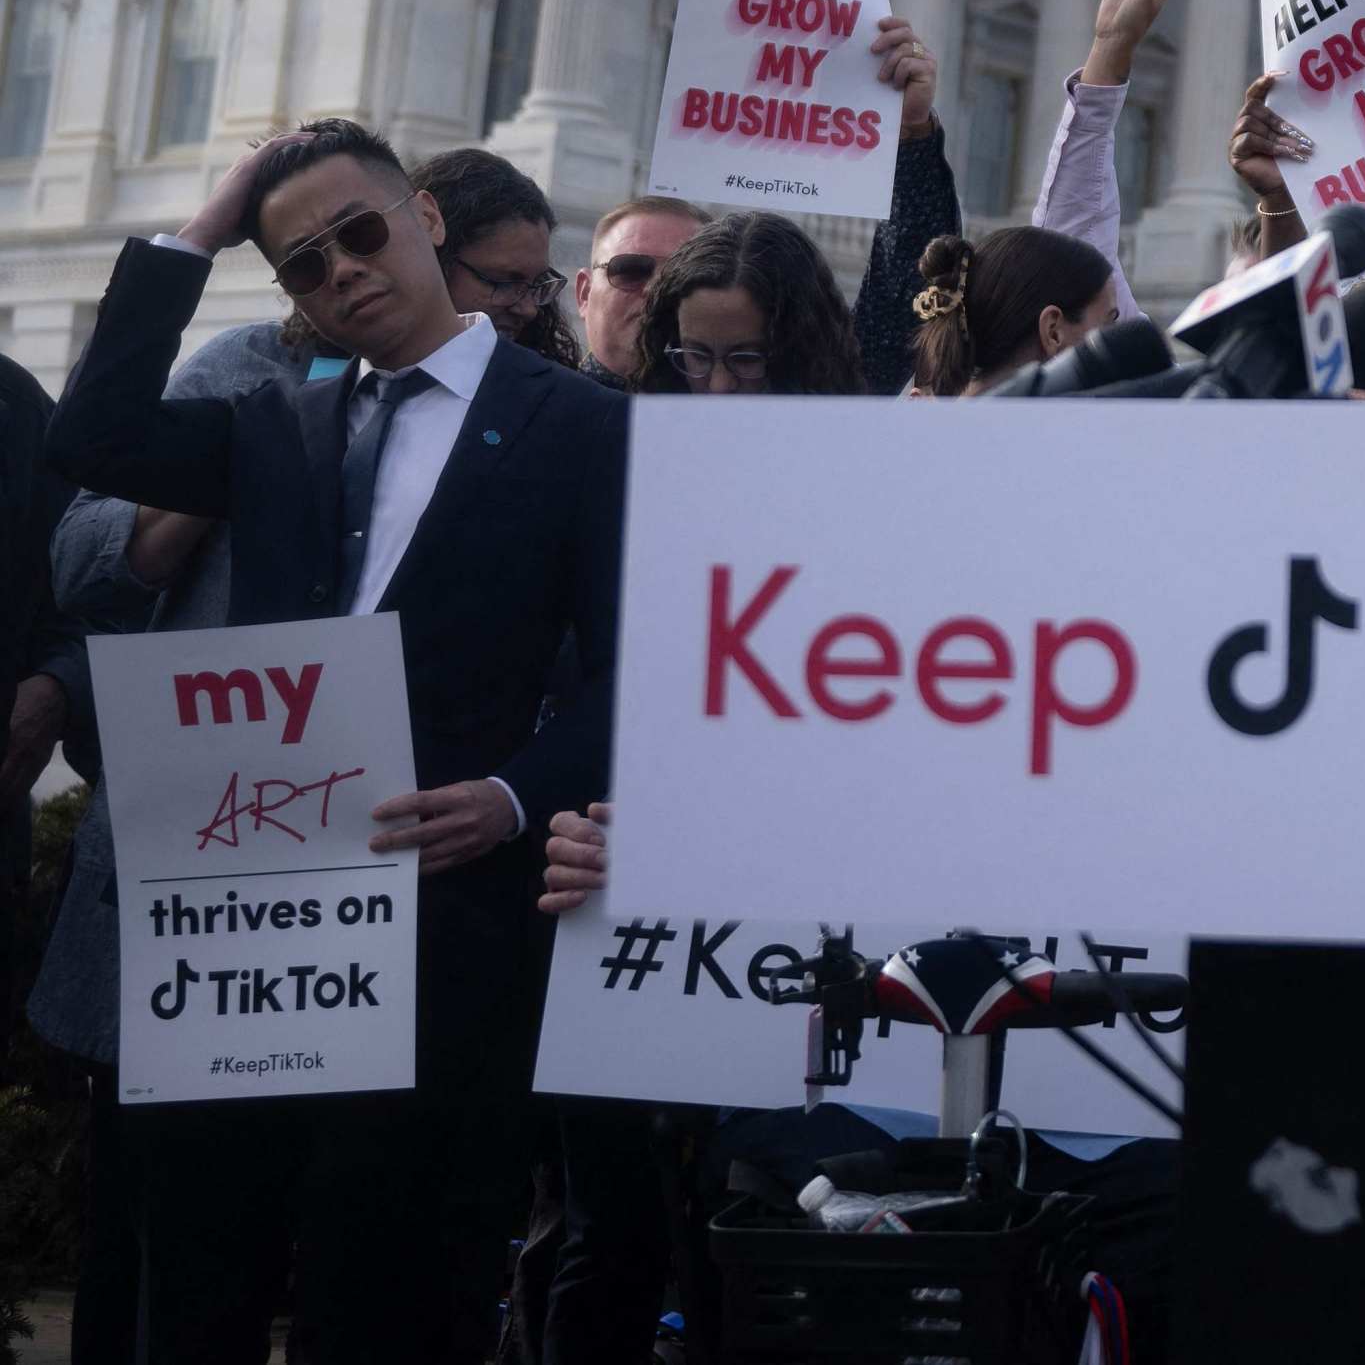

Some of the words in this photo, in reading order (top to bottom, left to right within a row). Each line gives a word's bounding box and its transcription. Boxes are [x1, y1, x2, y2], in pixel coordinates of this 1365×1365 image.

[756, 42, 828, 87] MY
[682, 87, 882, 150] BUSINESS
[725, 172, 820, 198] #KeepTikTok
[702, 562, 1140, 777] Keep
[173, 663, 325, 744] my
[196, 767, 366, 850] ART
[149, 890, 322, 937] thrives
[336, 893, 393, 926] on
[208, 963, 380, 1016] TikTok
[210, 1051, 325, 1076] #KeepTikTok
